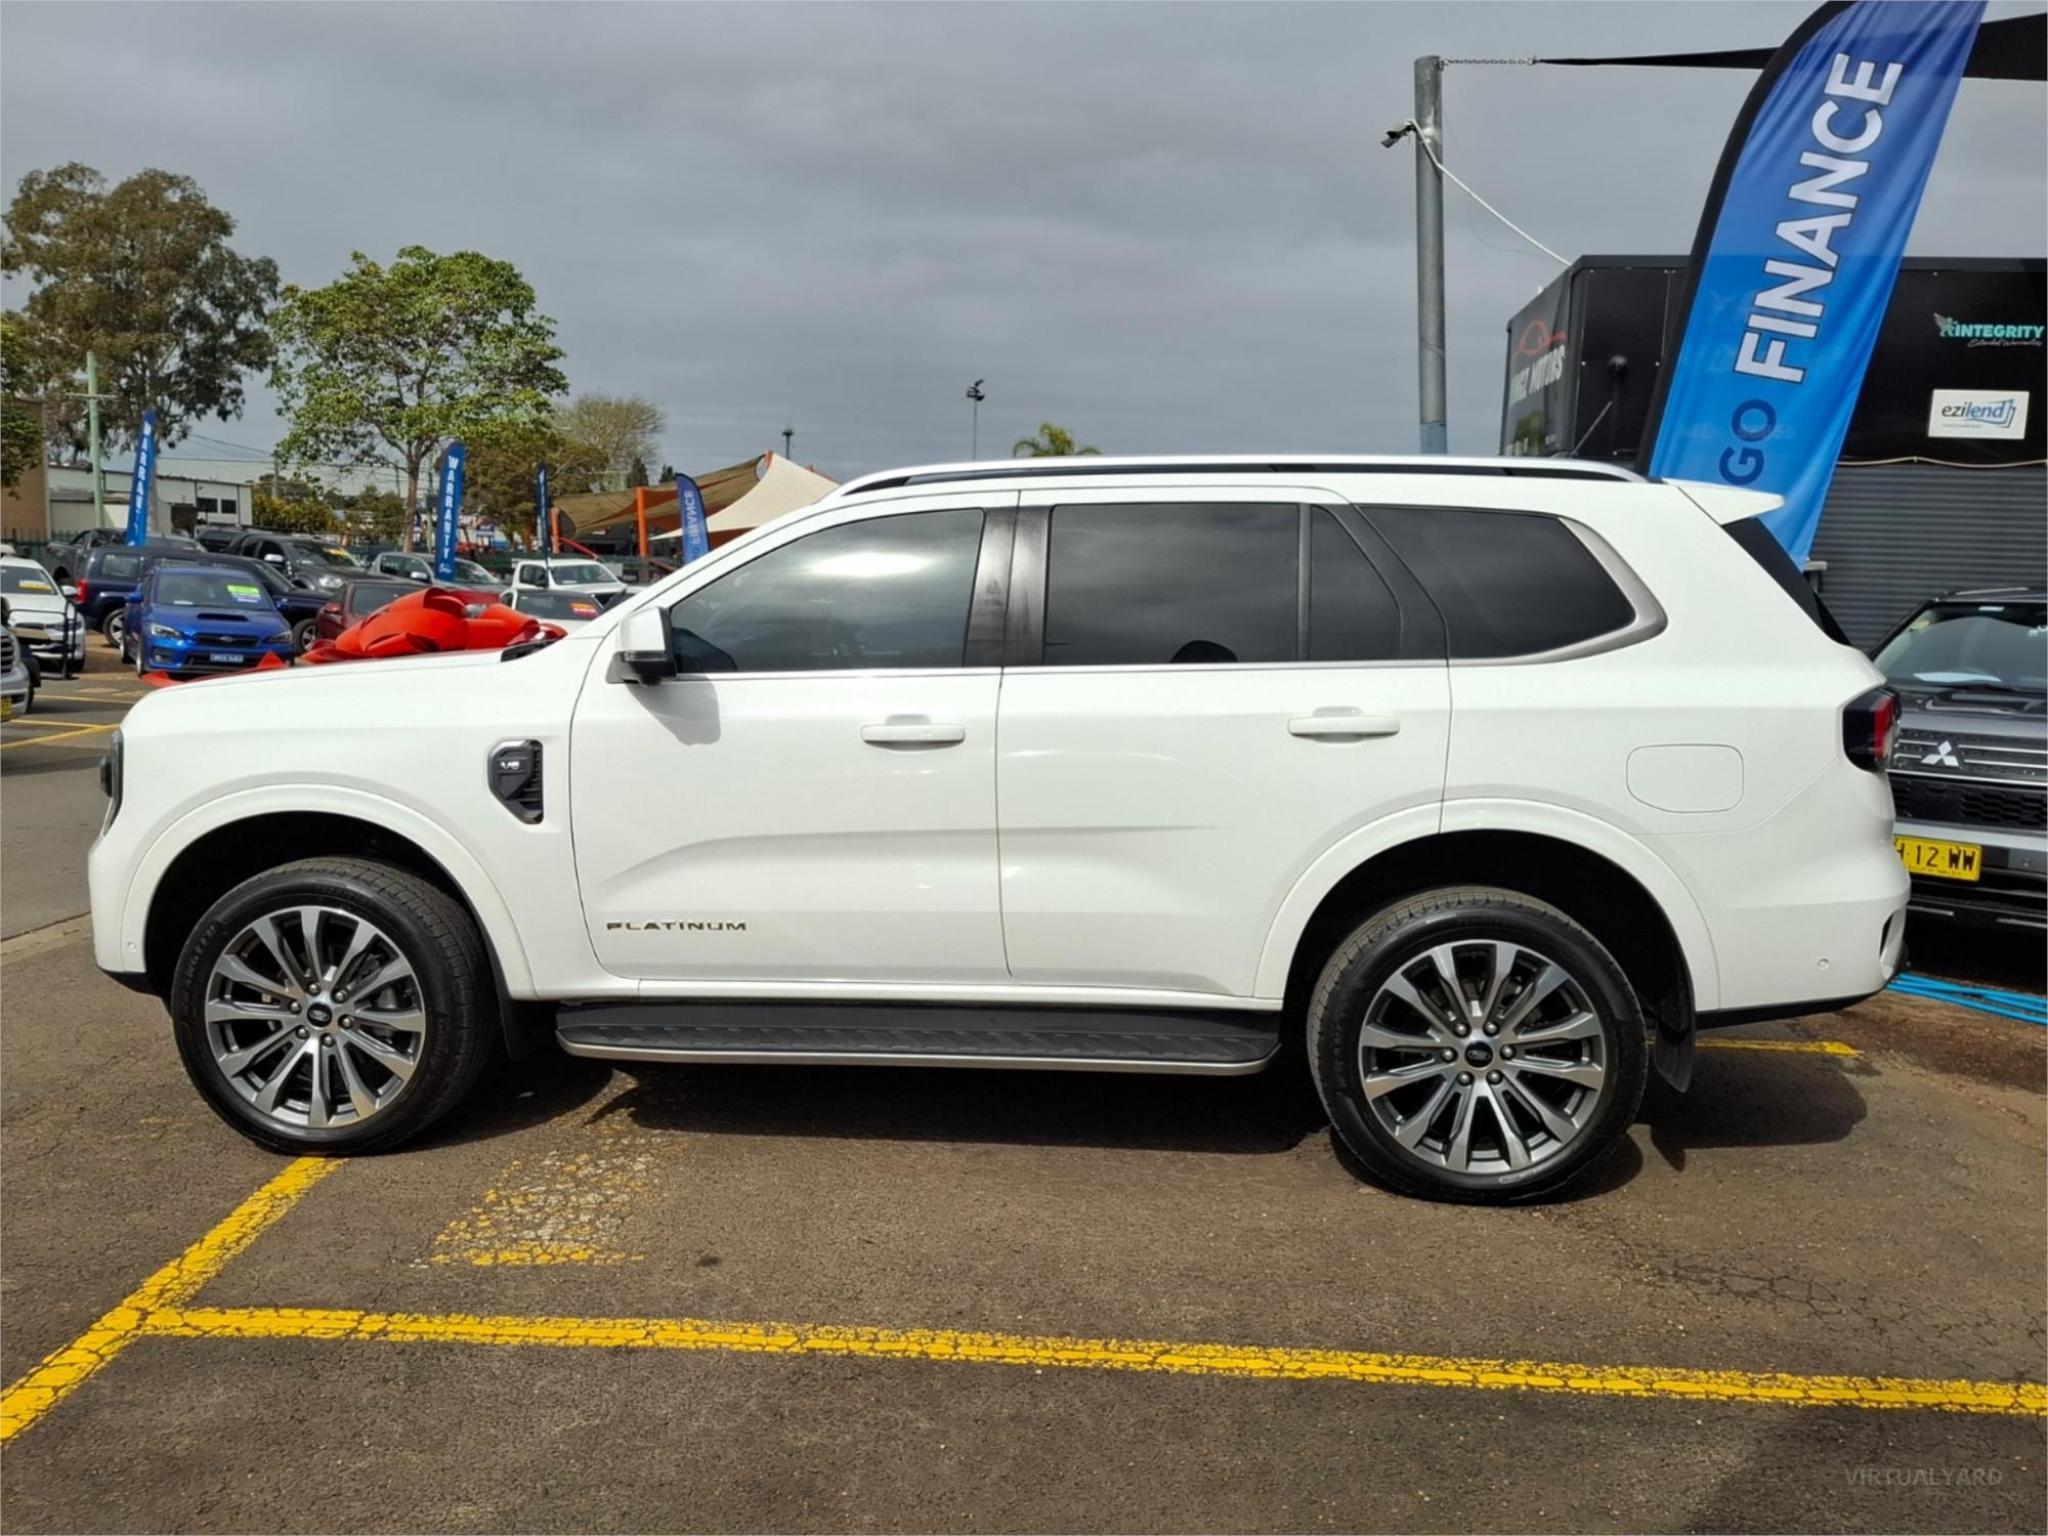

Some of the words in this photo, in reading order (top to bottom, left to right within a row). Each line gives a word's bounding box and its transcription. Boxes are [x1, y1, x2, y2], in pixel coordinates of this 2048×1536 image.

[1733, 52, 1905, 384] FINANCE
[1954, 323, 2045, 339] INTEGRITY
[1941, 401, 2005, 418] ezilend
[1719, 399, 1776, 486] GO
[444, 455, 459, 559] WARRANTY
[606, 921, 747, 932] PLATINUM
